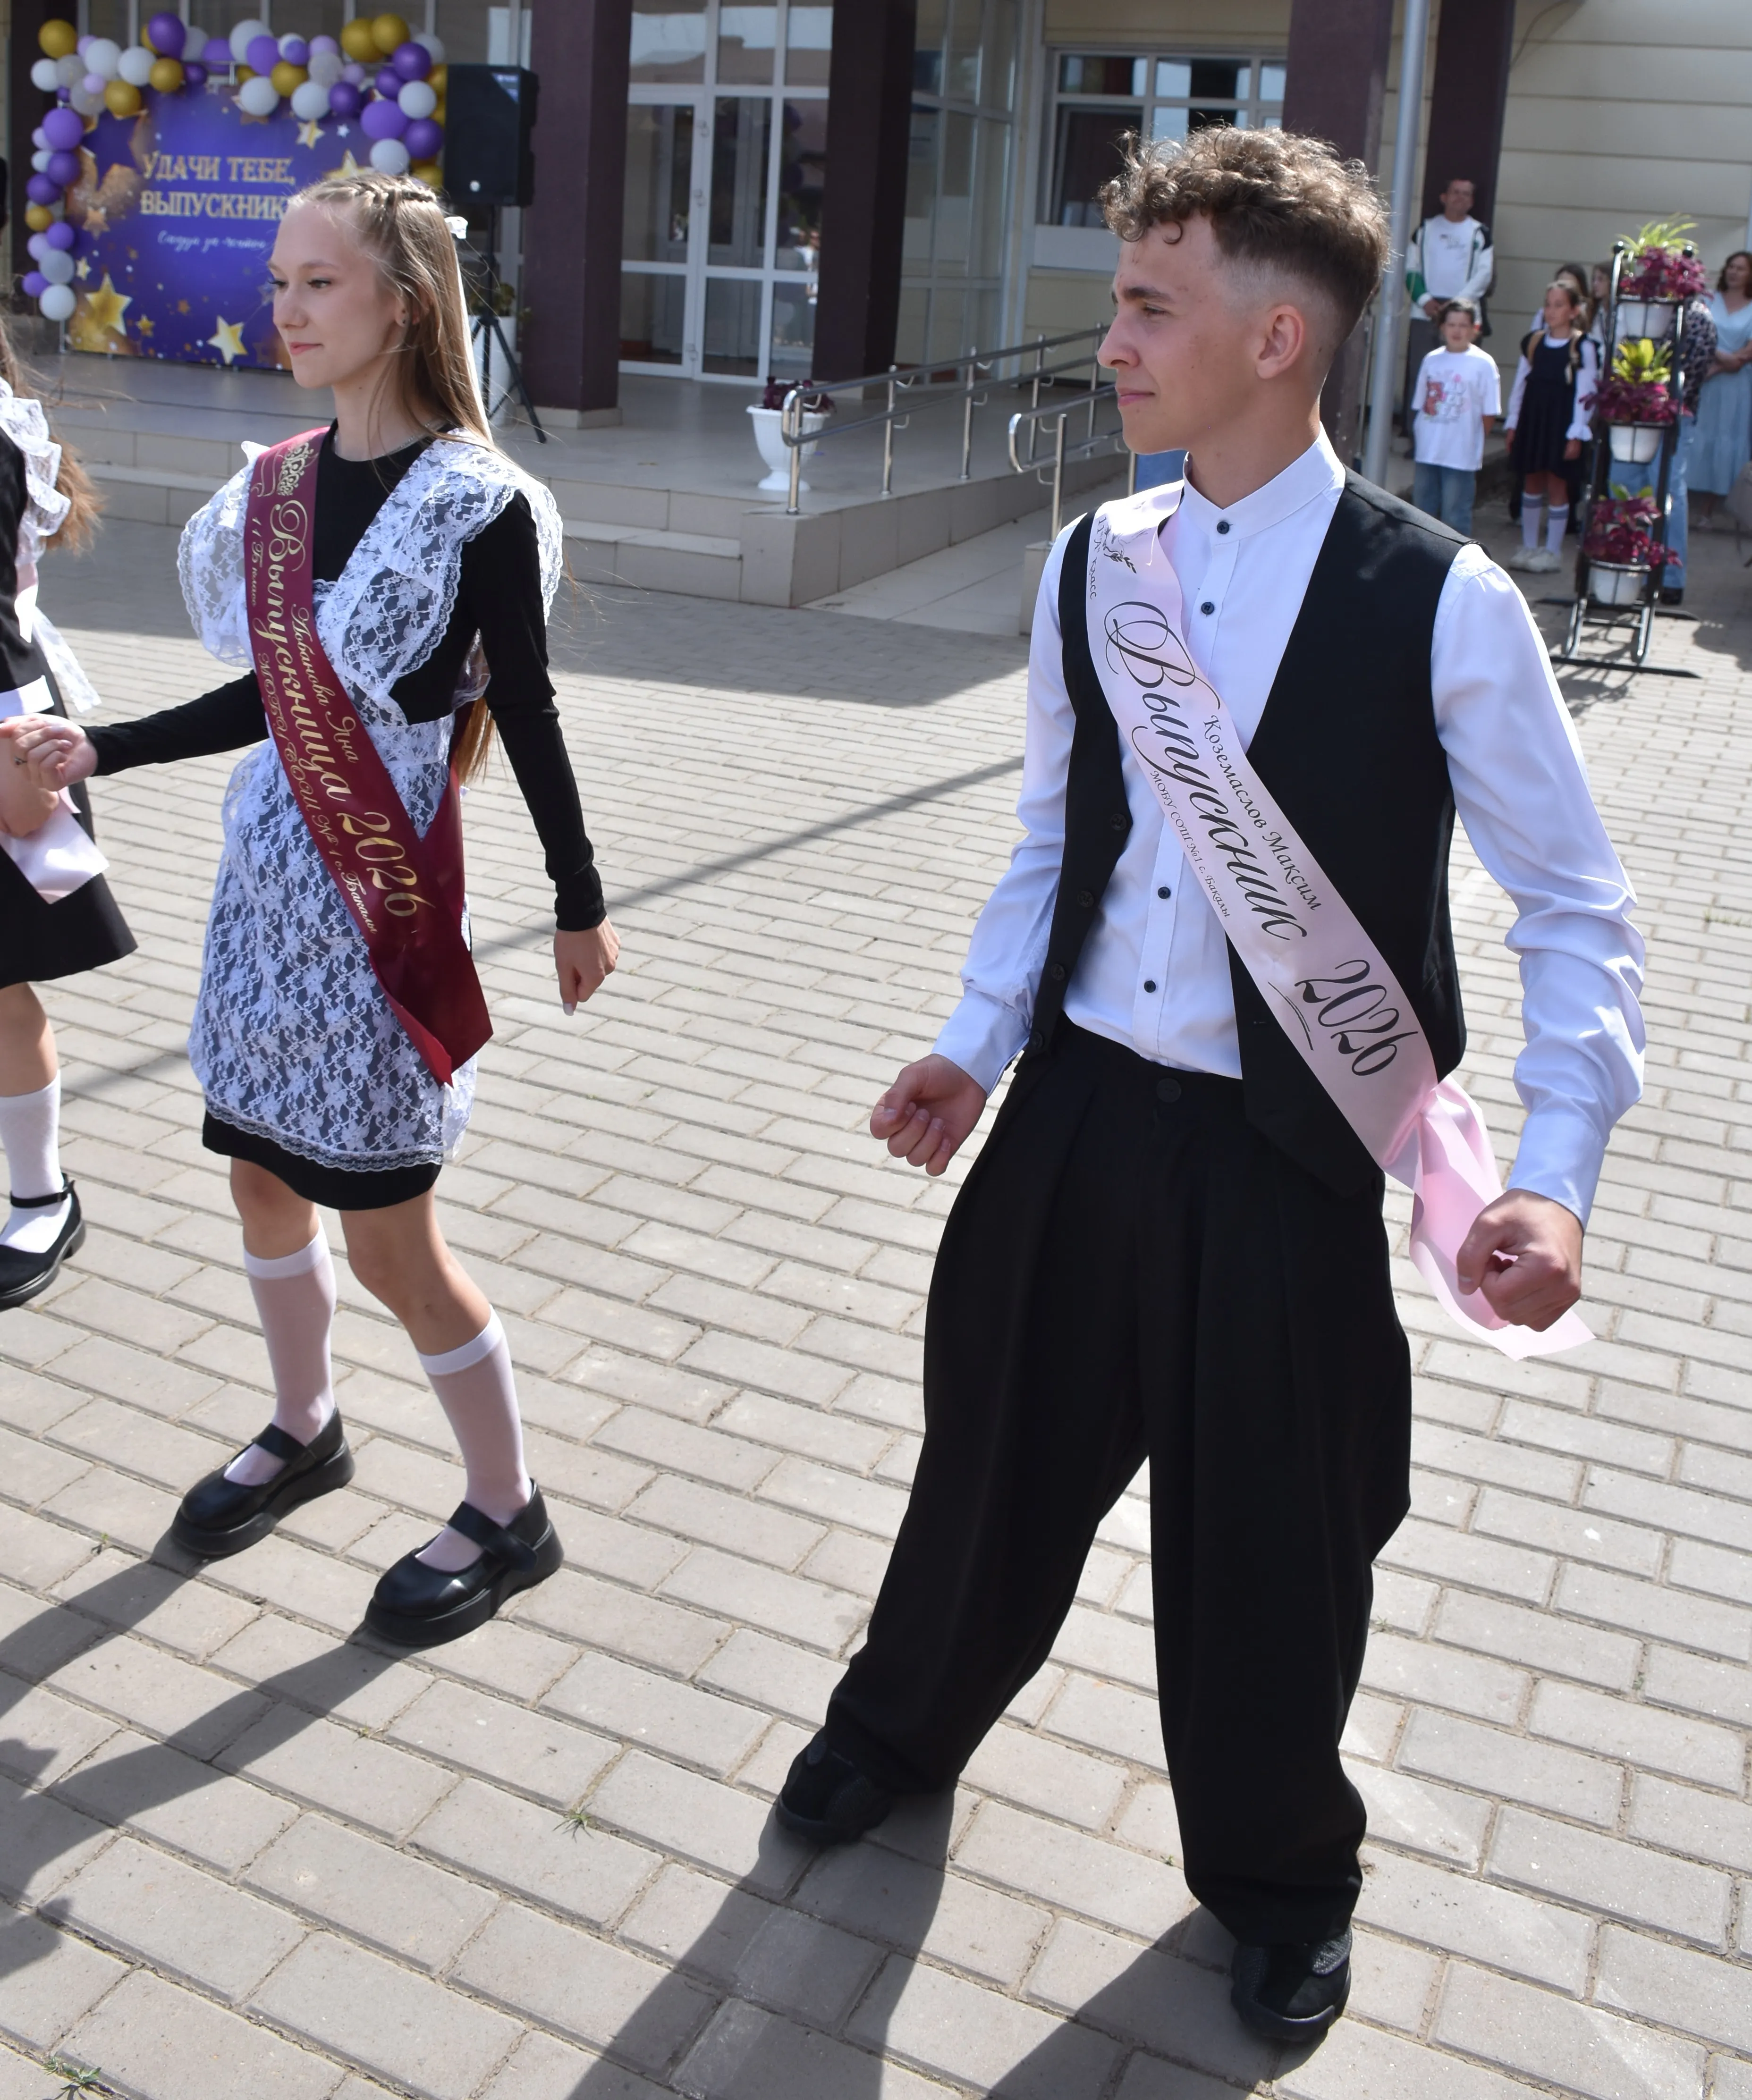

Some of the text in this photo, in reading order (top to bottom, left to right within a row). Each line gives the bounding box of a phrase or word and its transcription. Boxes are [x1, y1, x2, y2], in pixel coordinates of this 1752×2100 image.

[142, 150, 296, 186] УДАЧИ ТЕБЕ,
[253, 500, 436, 917] Выпускница 2026
[291, 603, 360, 763] Лобанова Яна
[285, 742, 322, 811] СОШ
[1104, 601, 1418, 1076] Выпускник 2026
[1150, 770, 1177, 809] МОБУ
[1170, 811, 1193, 843] СОШ
[1199, 866, 1206, 874] с.
[1204, 875, 1231, 918] Бакалы
[1203, 715, 1322, 911] Коземаслов Максим
